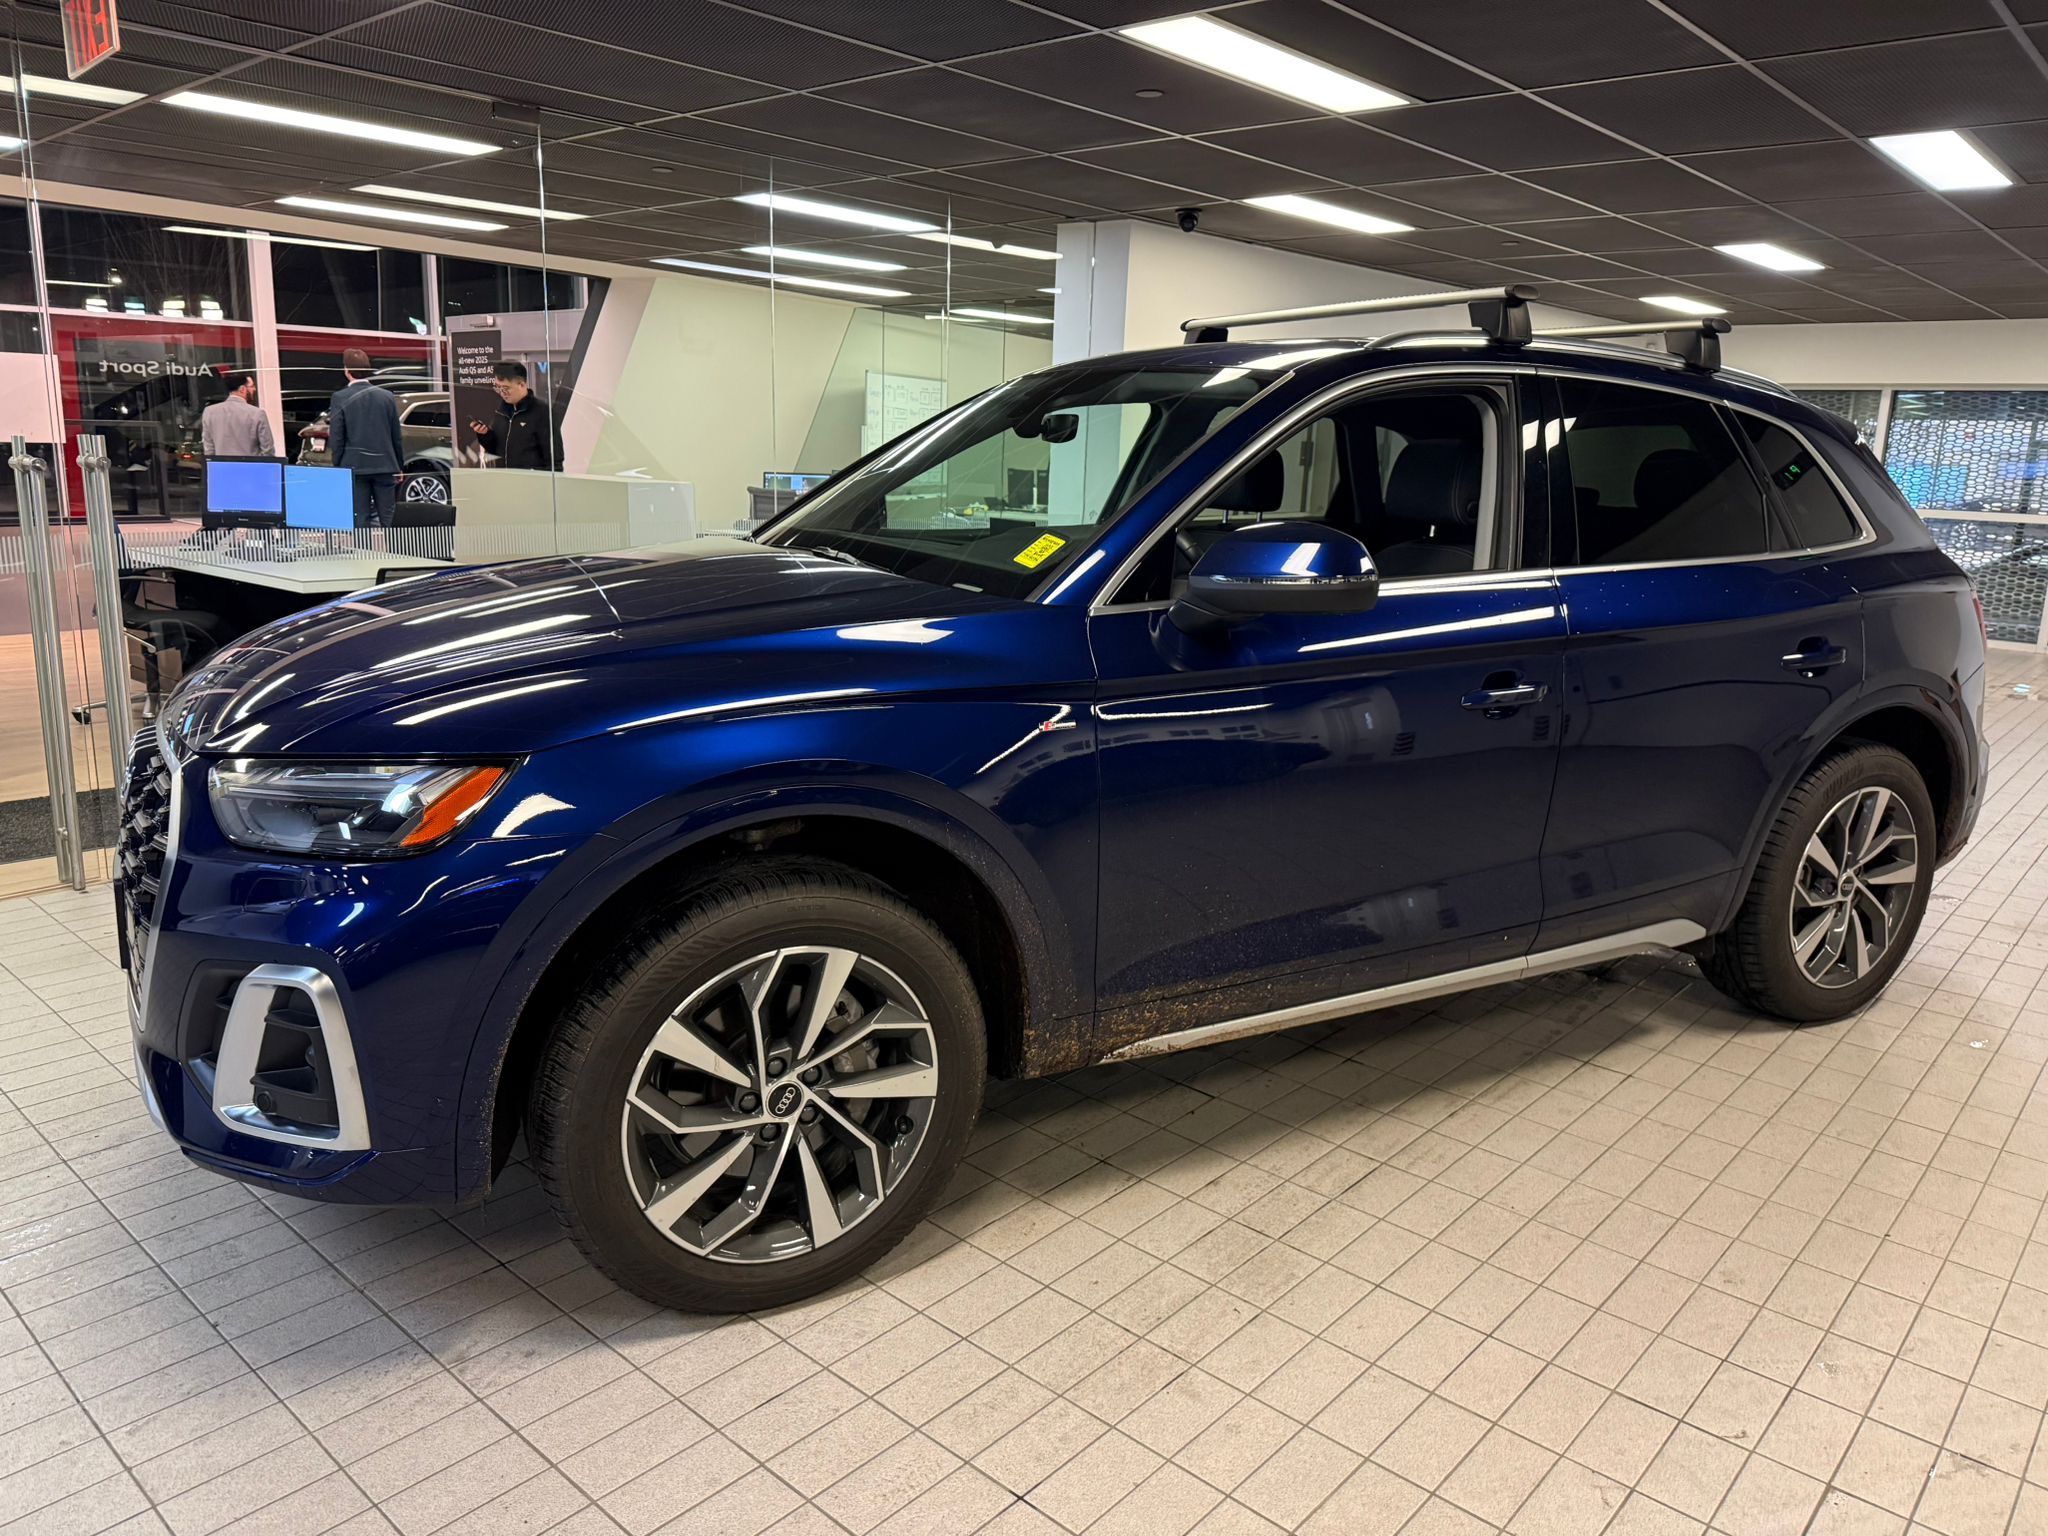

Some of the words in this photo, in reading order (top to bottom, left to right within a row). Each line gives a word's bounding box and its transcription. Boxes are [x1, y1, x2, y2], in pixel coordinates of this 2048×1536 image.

[456, 346, 479, 355] Welcome
[458, 357, 475, 365] all-new
[475, 355, 489, 364] 2025
[459, 366, 469, 374] Audi
[469, 366, 477, 375] Q5
[477, 366, 487, 374] and
[459, 376, 474, 385] family
